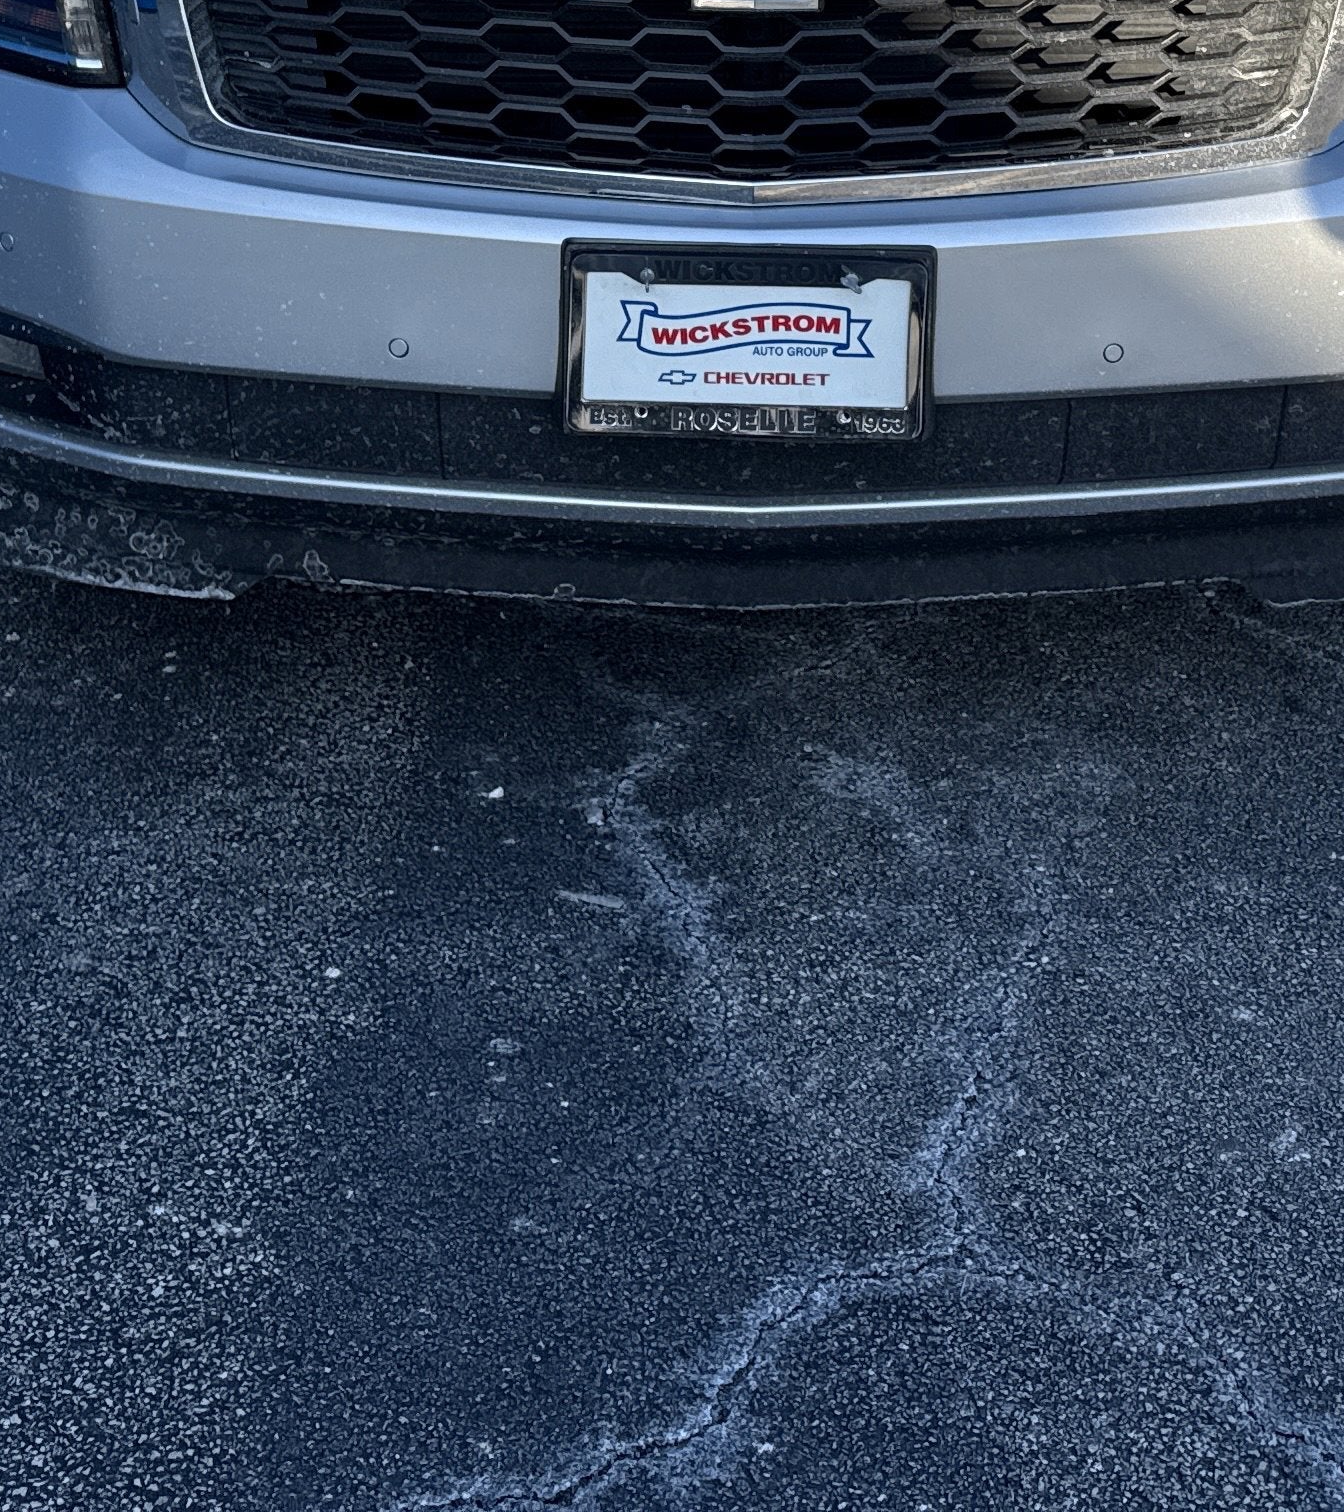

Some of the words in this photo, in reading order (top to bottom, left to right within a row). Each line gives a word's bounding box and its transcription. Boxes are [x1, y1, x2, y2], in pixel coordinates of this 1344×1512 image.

[654, 259, 841, 284] WICKSTROM
[651, 314, 841, 345] WICKSTROM
[753, 347, 784, 357] AUTO
[787, 347, 829, 358] GROUP
[703, 371, 831, 386] CHEVROLET
[671, 406, 817, 433] ROSELLE
[854, 414, 907, 433] 1963
